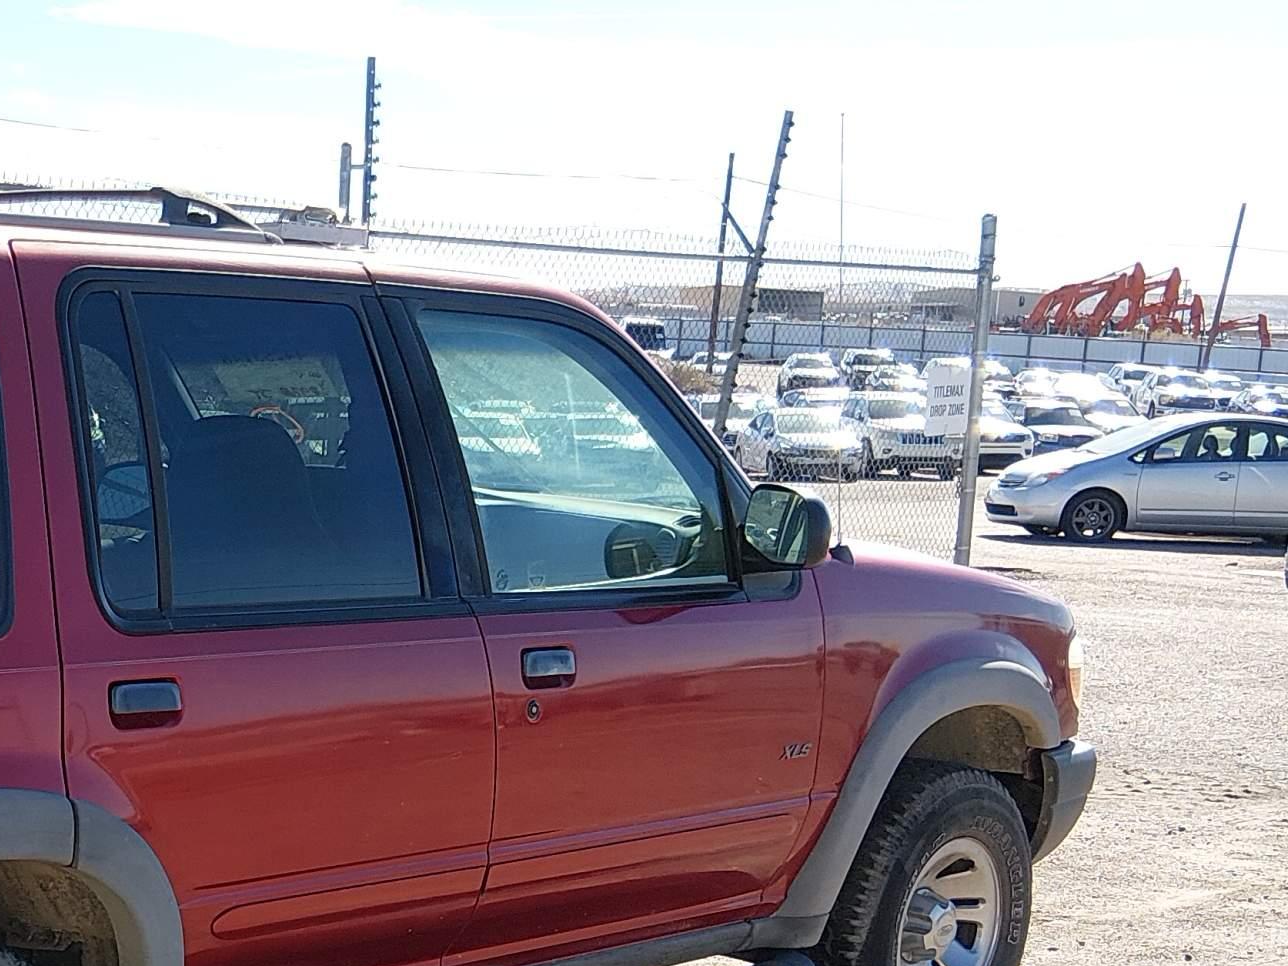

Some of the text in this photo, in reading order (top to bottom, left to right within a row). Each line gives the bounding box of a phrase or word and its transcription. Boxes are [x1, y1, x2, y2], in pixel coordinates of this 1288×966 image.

[933, 384, 965, 398] TITLEMAX
[929, 403, 965, 417] DROP ZONE
[778, 743, 813, 760] XLS
